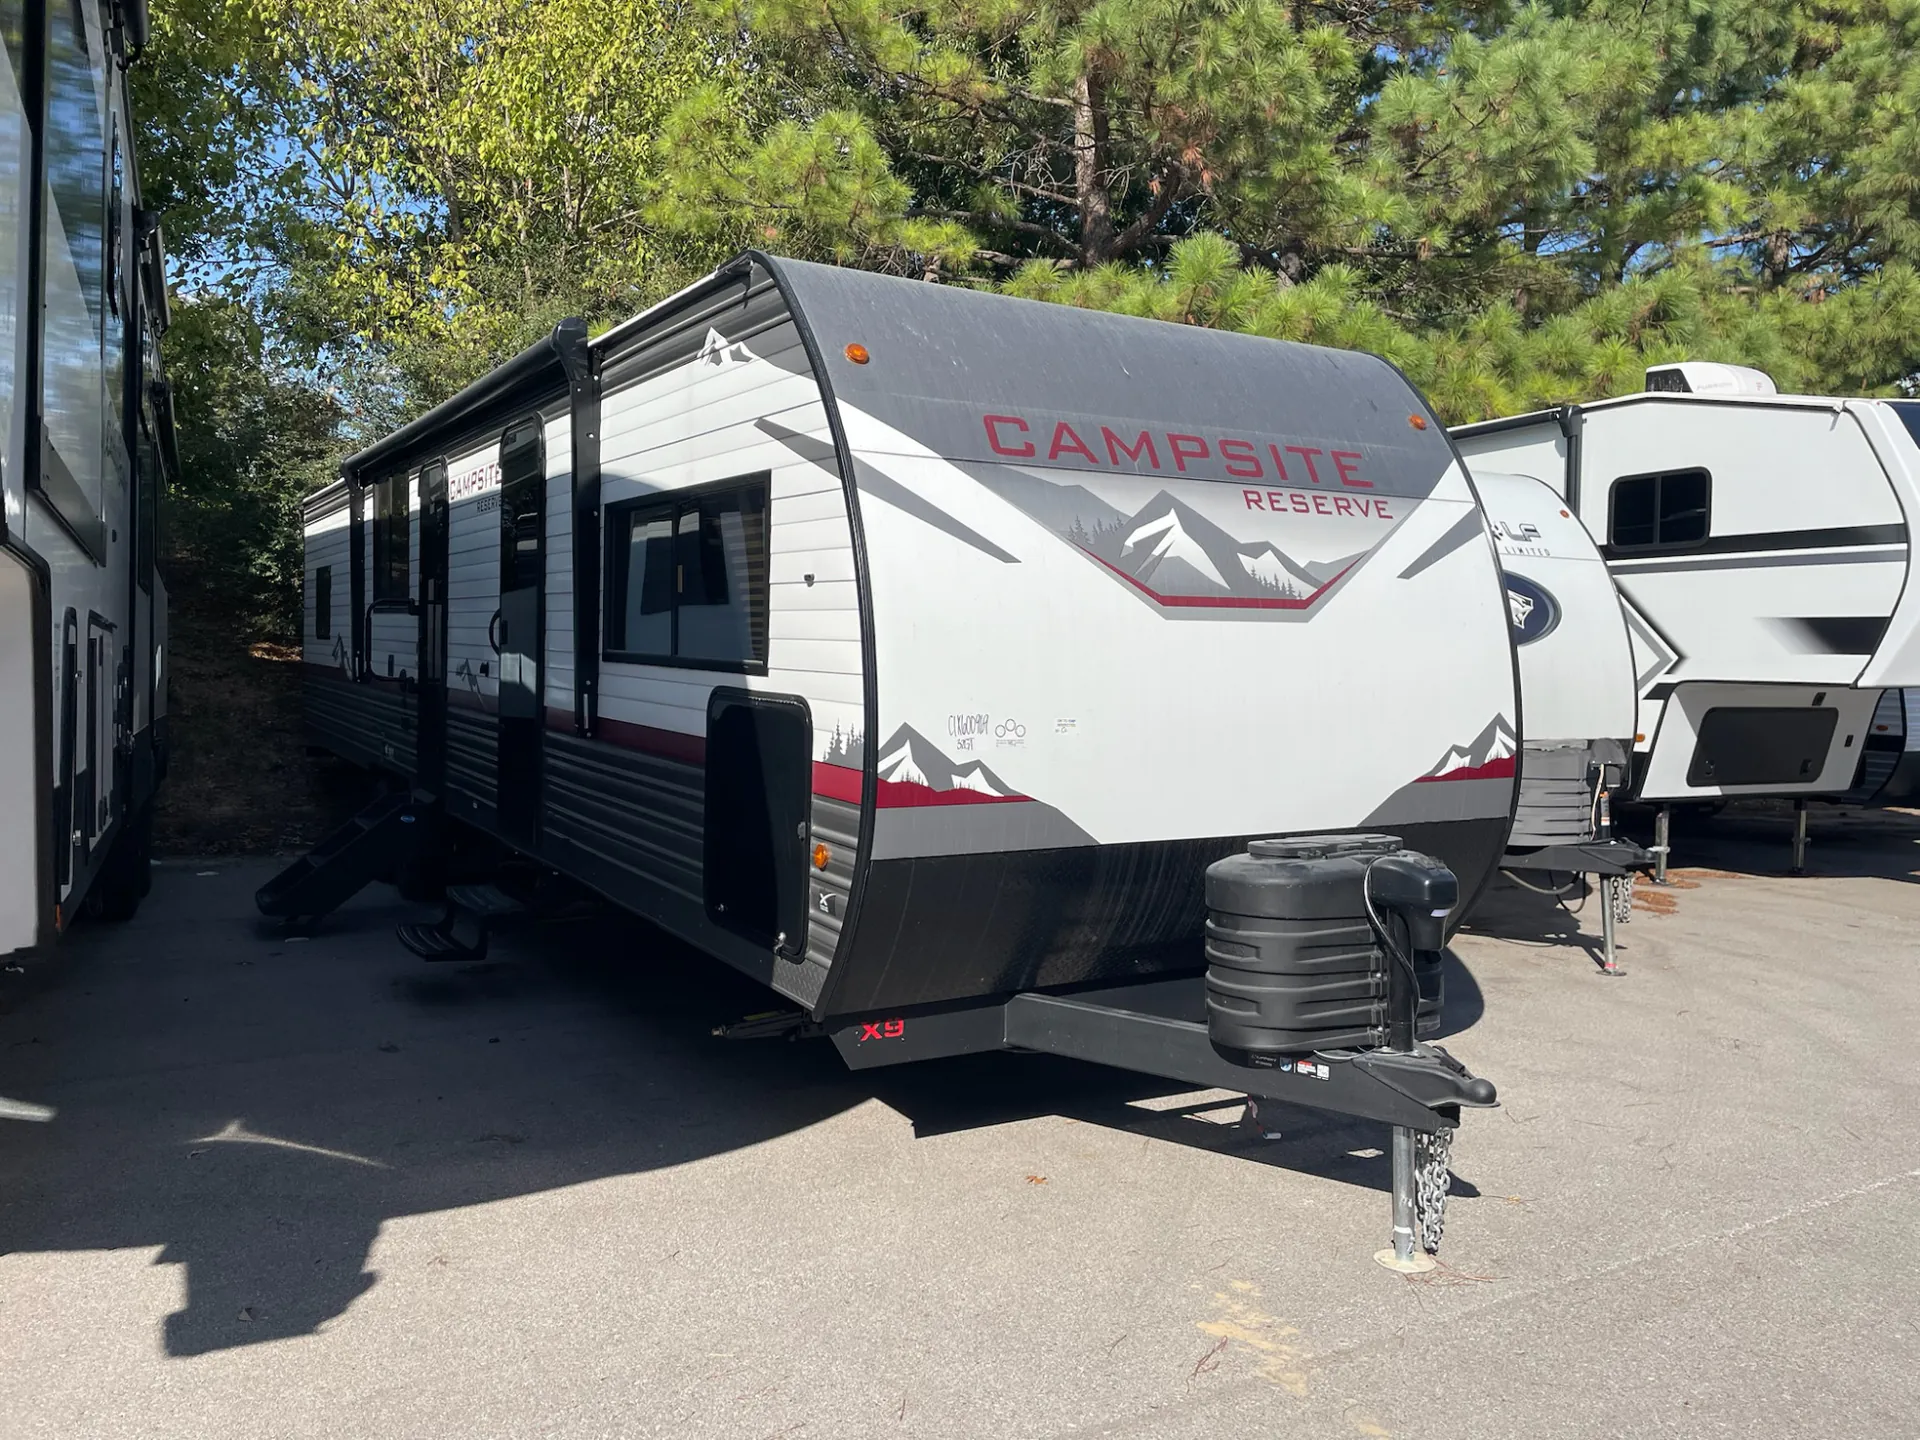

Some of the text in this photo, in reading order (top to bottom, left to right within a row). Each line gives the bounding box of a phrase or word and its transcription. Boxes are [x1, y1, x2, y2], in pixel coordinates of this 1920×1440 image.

[983, 414, 1375, 488] CAMPSITE
[450, 463, 503, 501] CAMPSITE
[1242, 490, 1393, 520] RESERVE
[1504, 546, 1551, 557] LIMITED
[860, 1018, 905, 1042] X9
